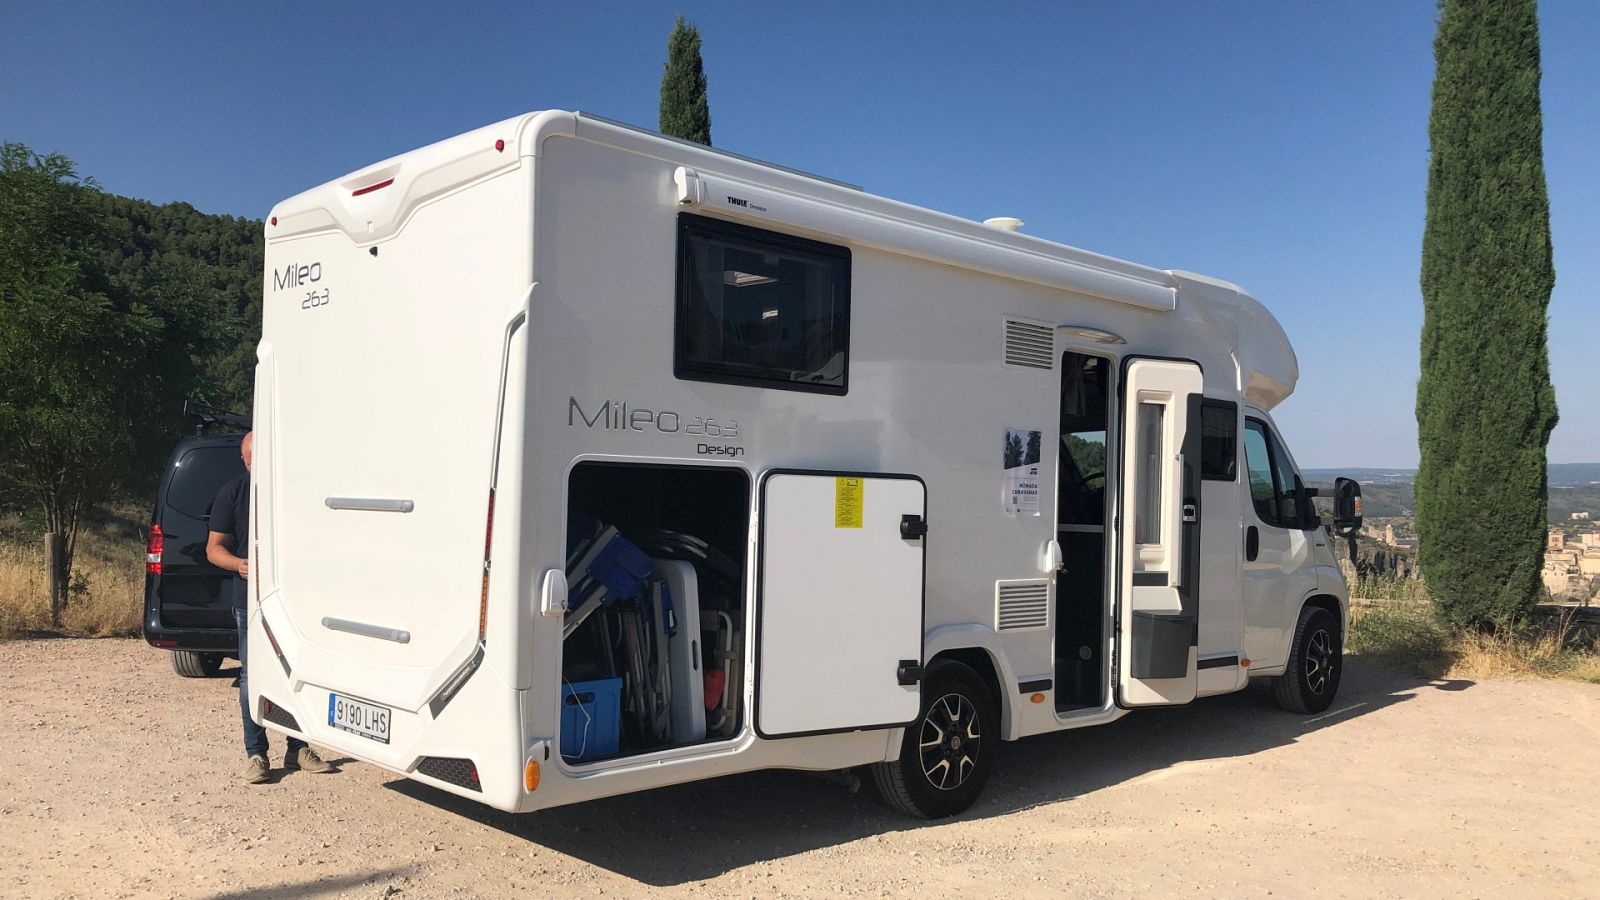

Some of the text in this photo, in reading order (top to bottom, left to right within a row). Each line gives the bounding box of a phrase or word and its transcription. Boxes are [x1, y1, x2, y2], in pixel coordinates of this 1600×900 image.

[727, 196, 748, 207] THULE
[273, 262, 321, 292] Mileo
[302, 288, 329, 309] 263
[568, 395, 738, 438] Mileo 263
[697, 443, 744, 457] Design
[337, 700, 387, 733] 9190 LHS
